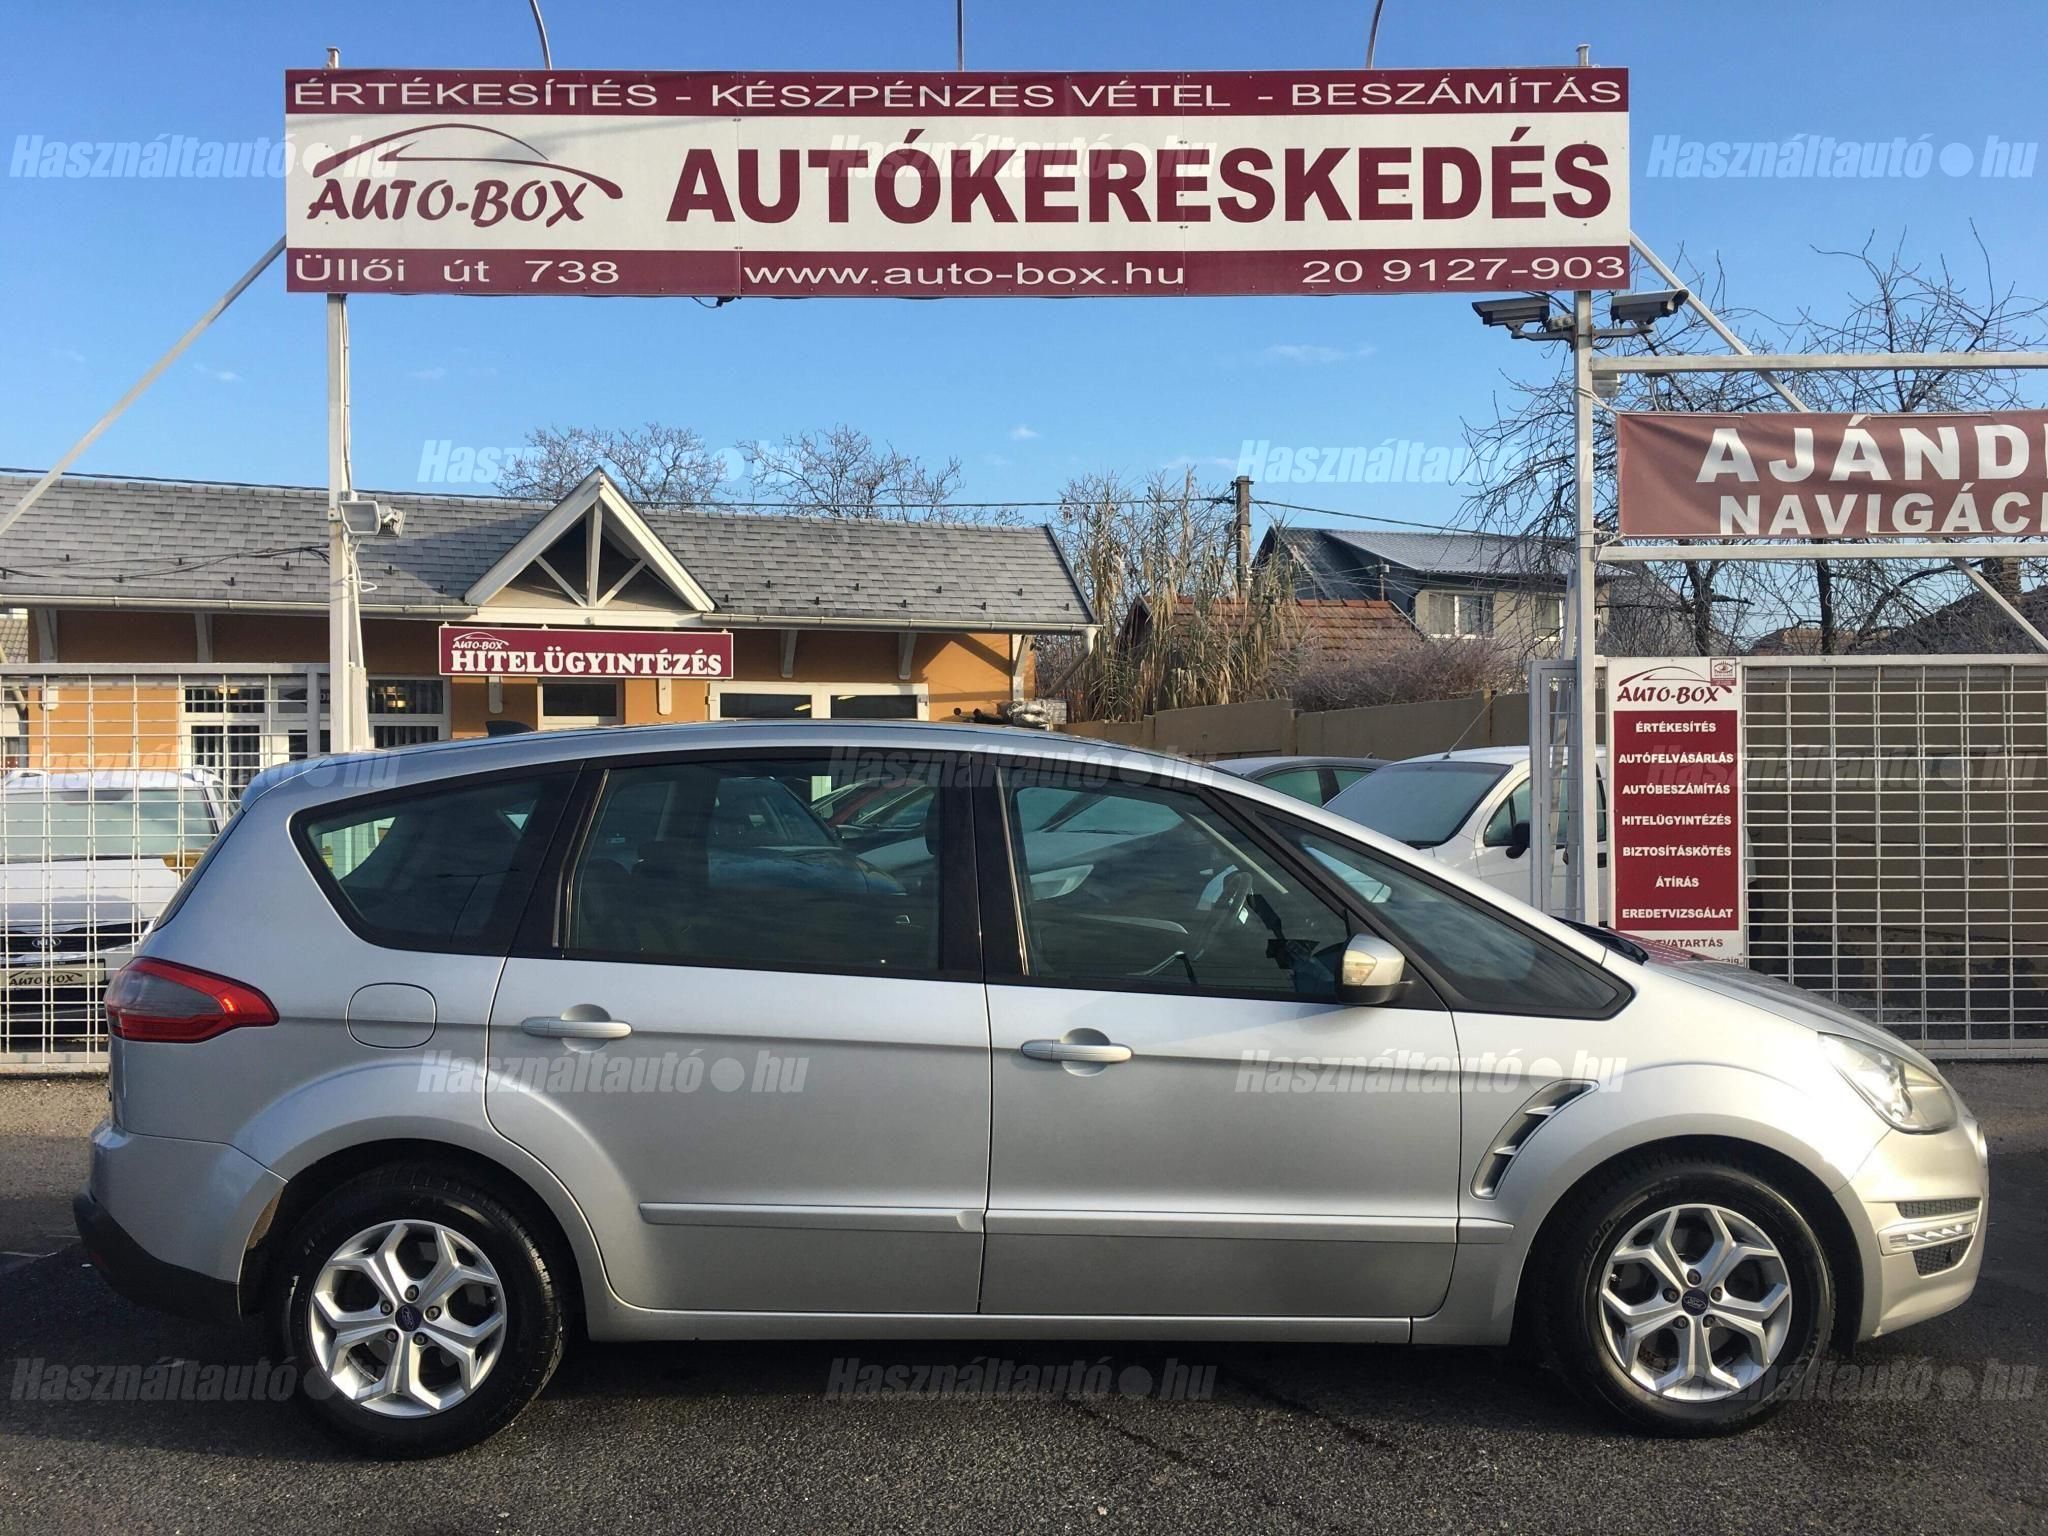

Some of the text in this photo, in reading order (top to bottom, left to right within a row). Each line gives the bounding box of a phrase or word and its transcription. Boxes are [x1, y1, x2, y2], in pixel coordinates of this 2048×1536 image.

[295, 76, 658, 108] ÉRTÉKESÍTÉS
[712, 79, 1055, 108] KÉSZPÉNZES
[1071, 79, 1231, 107] VÉTEL
[1292, 76, 1622, 106] BESZÁMÍTÁS
[666, 126, 1611, 225] AUTÓKERESKEDÉS
[307, 178, 588, 228] AUTO-BOX
[296, 254, 1625, 287] Üllői út 738 www.auto-box.hu 20 9127-903
[1696, 415, 2048, 483] AJÁND
[452, 639, 504, 651] AUTO-BOX
[450, 645, 723, 676] HITELÜGYINTÉZÉS
[1617, 685, 1720, 705] AUTO-BOX
[1635, 719, 1717, 734] ÉRTÉKESÍTÉS
[1618, 751, 1734, 764] AUTÓFELVÁSÁRLÁS
[1622, 782, 1731, 796] AUTÓBESZÁMÍTÁS
[1621, 813, 1732, 827] HITELÜGYINTÉZÉS
[1622, 844, 1732, 857] BIZTOSÍTÁSKÖTÉS
[1655, 875, 1700, 888] ÁTÍRÁS
[1622, 906, 1734, 919] EREDETVIZSGÁLAT
